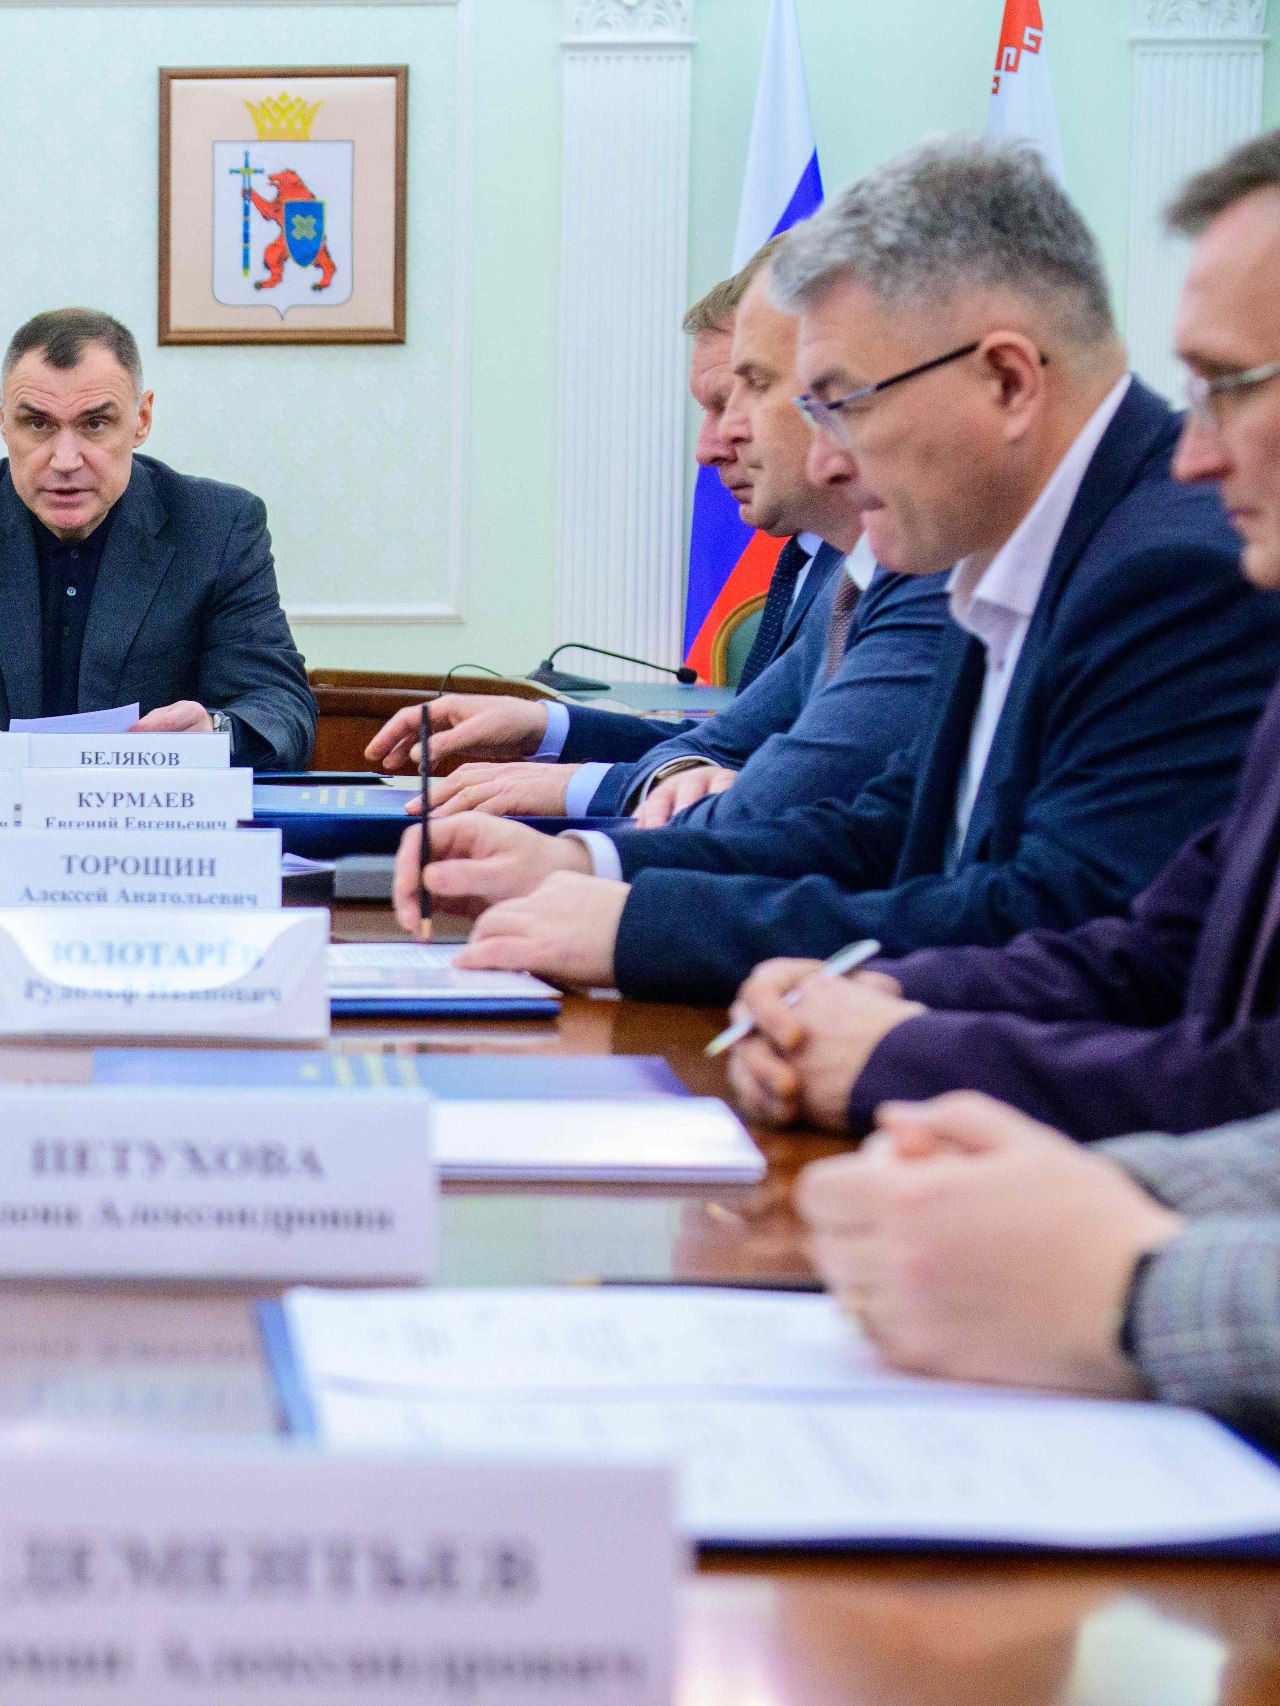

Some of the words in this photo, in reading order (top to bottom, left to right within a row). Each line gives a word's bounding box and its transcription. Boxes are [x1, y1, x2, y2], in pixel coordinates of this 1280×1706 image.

[80, 751, 180, 766] БЕЛЯКОВ
[77, 792, 195, 808] КУРМАЕВ
[45, 816, 118, 828] Евгений
[125, 816, 227, 829] Евгеньевич
[61, 854, 217, 879] ТОРОЩИН
[22, 886, 108, 904] Алексей
[118, 886, 258, 905] Анатольевич
[30, 1138, 326, 1180] ПЕТУХОВА
